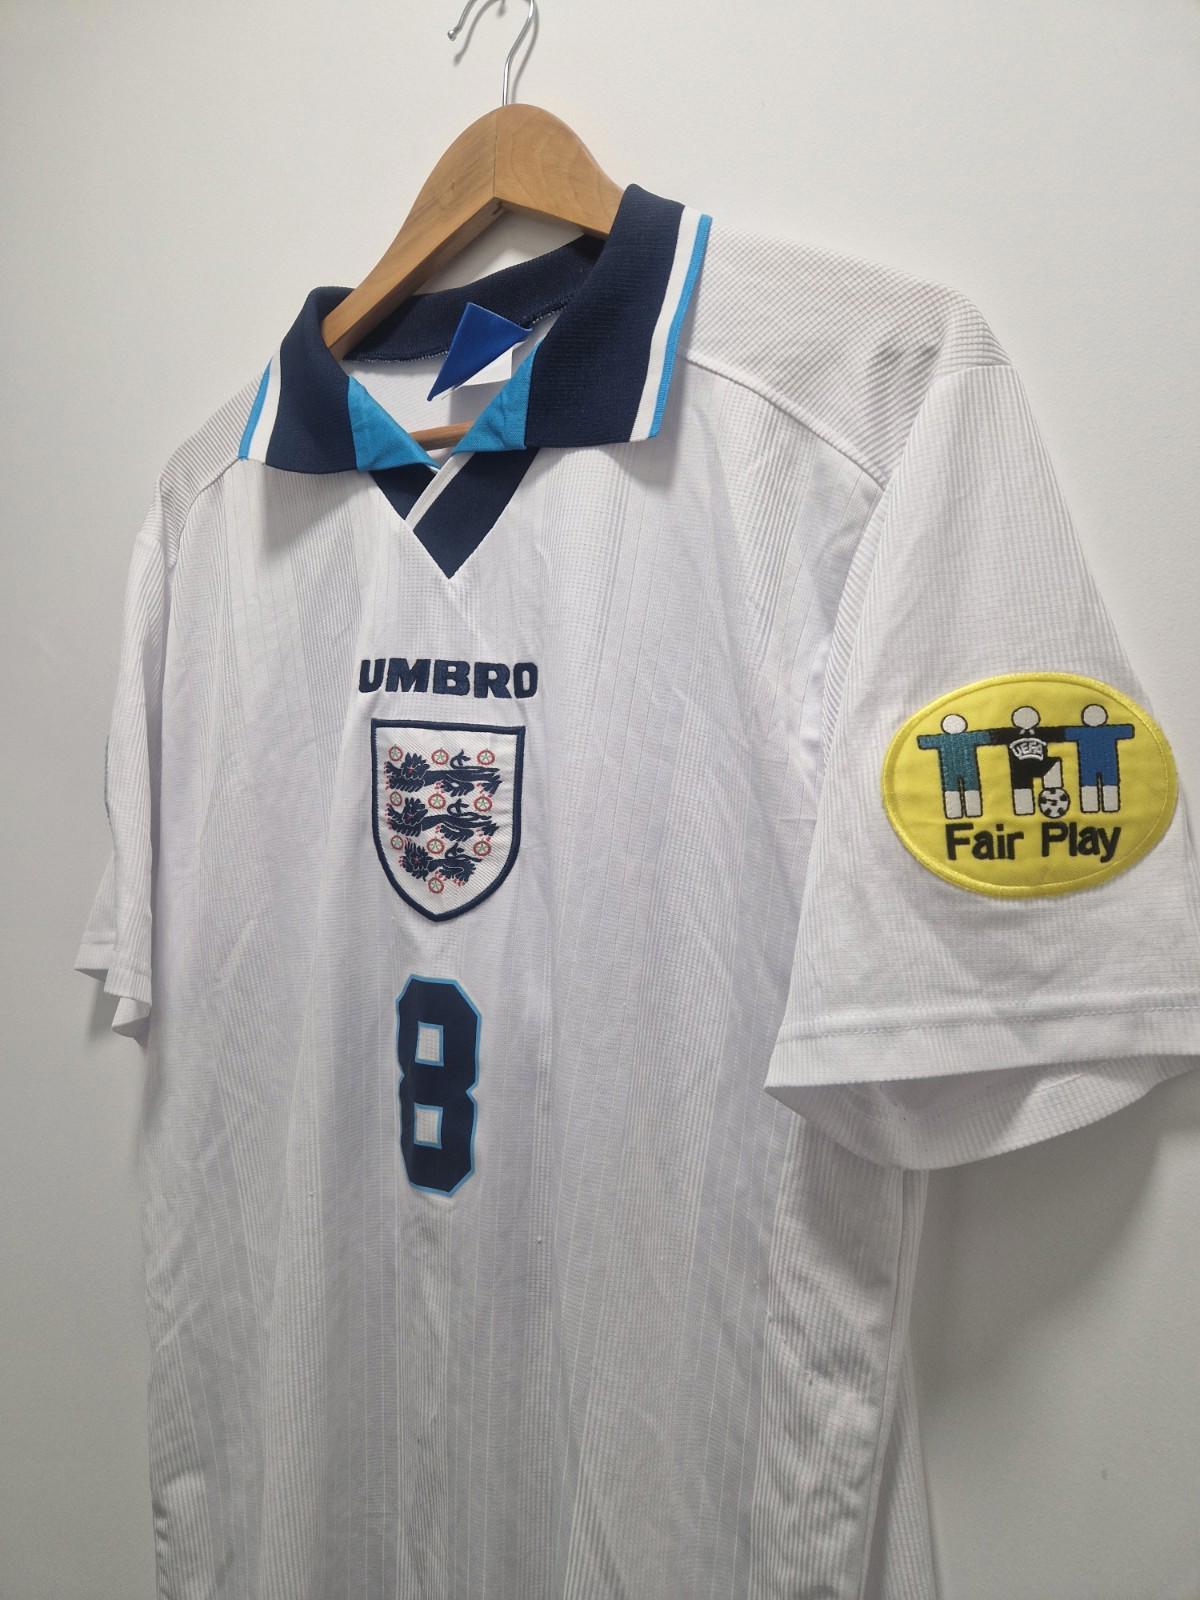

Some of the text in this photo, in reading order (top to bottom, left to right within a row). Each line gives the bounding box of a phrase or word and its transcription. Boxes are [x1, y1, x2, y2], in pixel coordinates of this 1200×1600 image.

[358, 657, 539, 699] UMBRO
[1012, 741, 1043, 757] UEFA
[945, 821, 1122, 863] Fair Play
[395, 973, 482, 1198] 8
